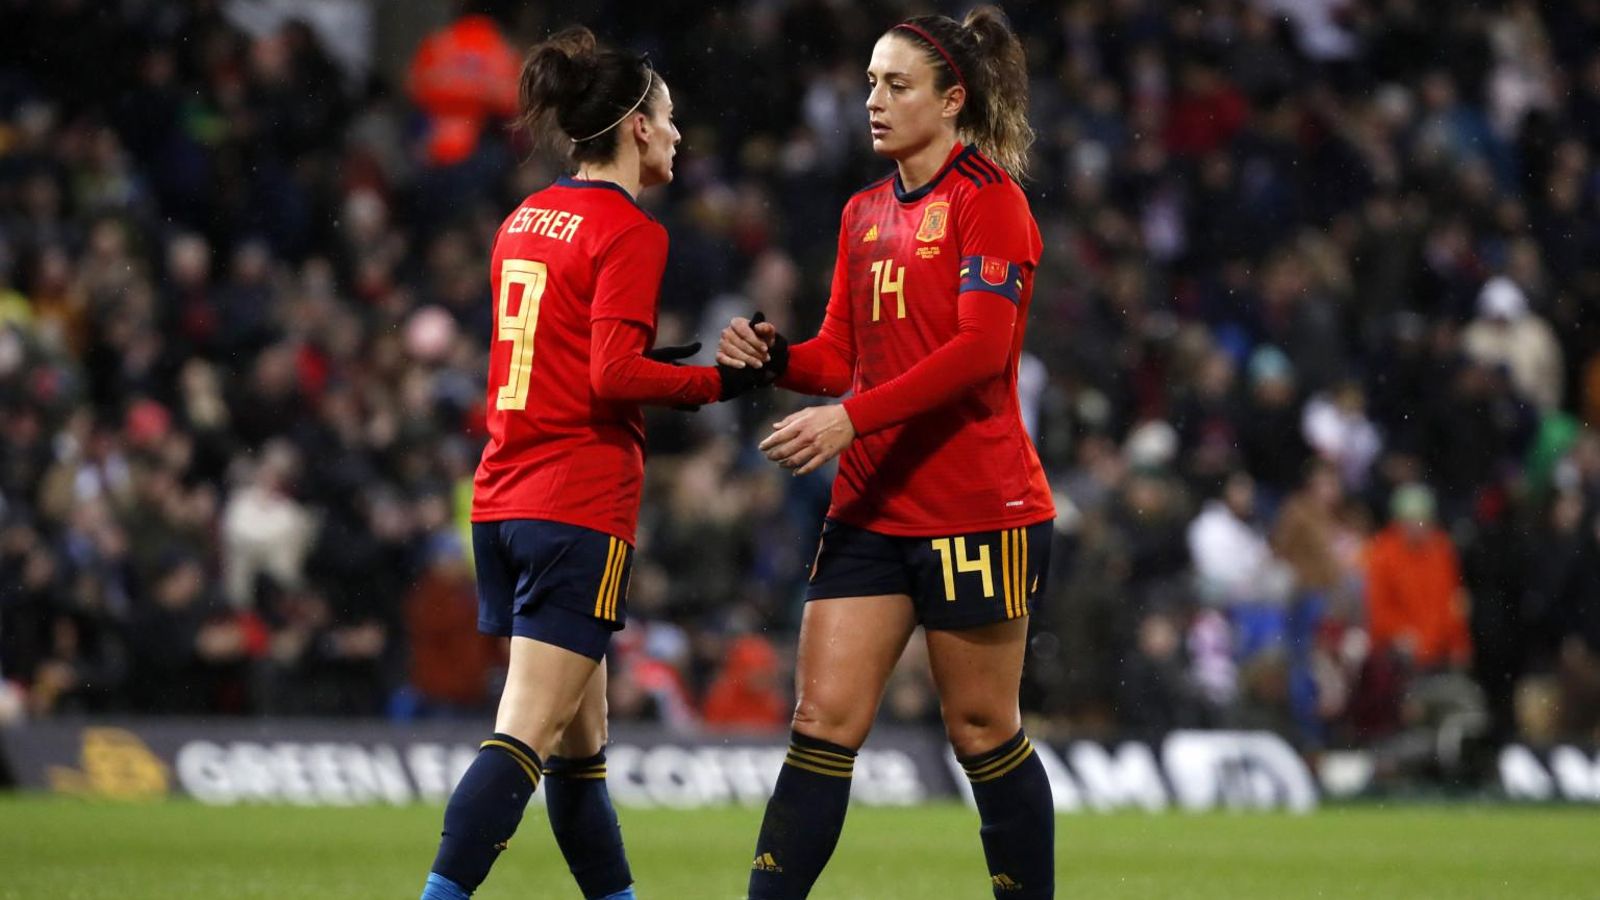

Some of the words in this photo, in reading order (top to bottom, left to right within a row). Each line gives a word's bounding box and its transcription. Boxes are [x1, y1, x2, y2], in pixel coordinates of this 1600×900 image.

[507, 207, 584, 243] ESTHER
[870, 259, 907, 322] 14
[496, 258, 548, 411] 9
[931, 536, 995, 601] 14
